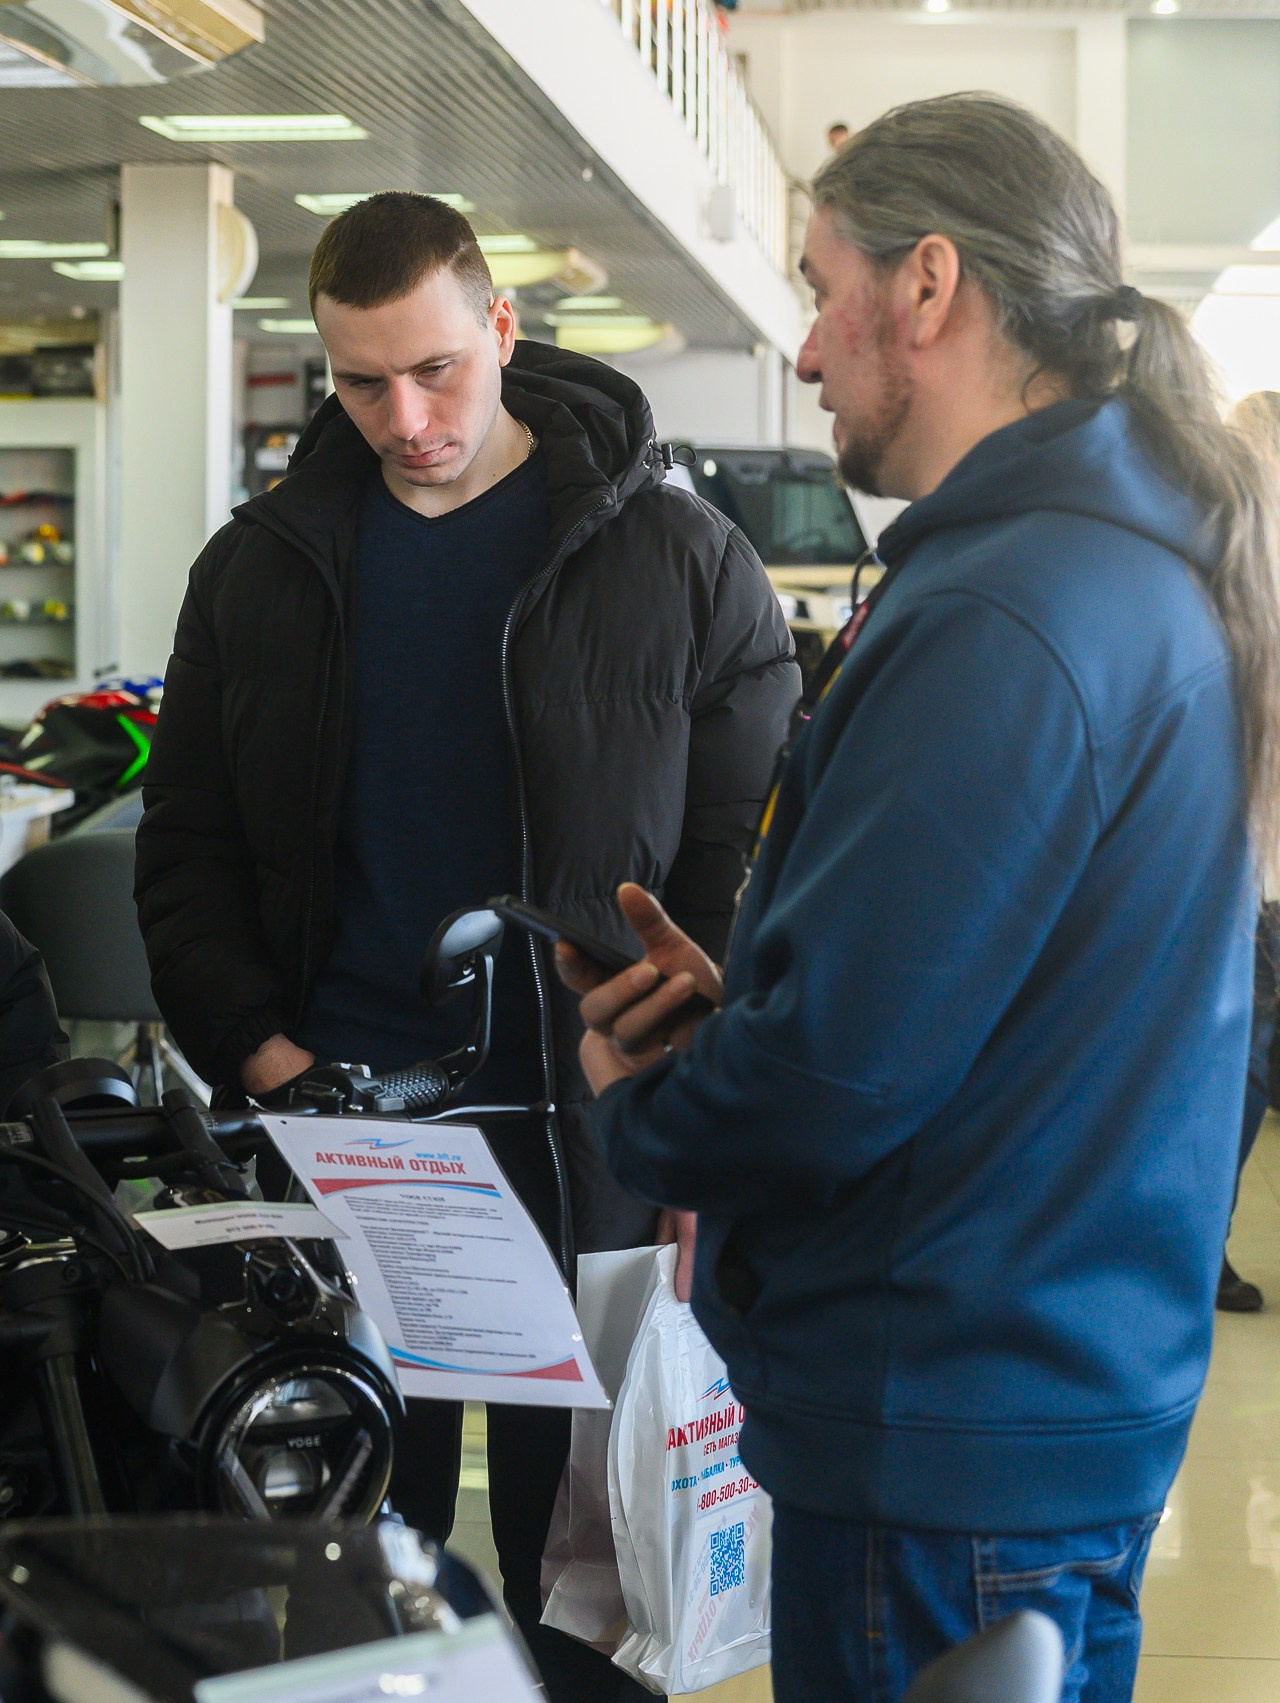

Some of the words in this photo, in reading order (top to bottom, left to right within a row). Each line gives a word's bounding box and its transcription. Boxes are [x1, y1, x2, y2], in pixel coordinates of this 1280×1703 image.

[315, 1151, 405, 1171] АКТИВНЫЙ
[409, 1158, 467, 1175] ОТДЫХ
[718, 1431, 741, 1450] МАГАЗ
